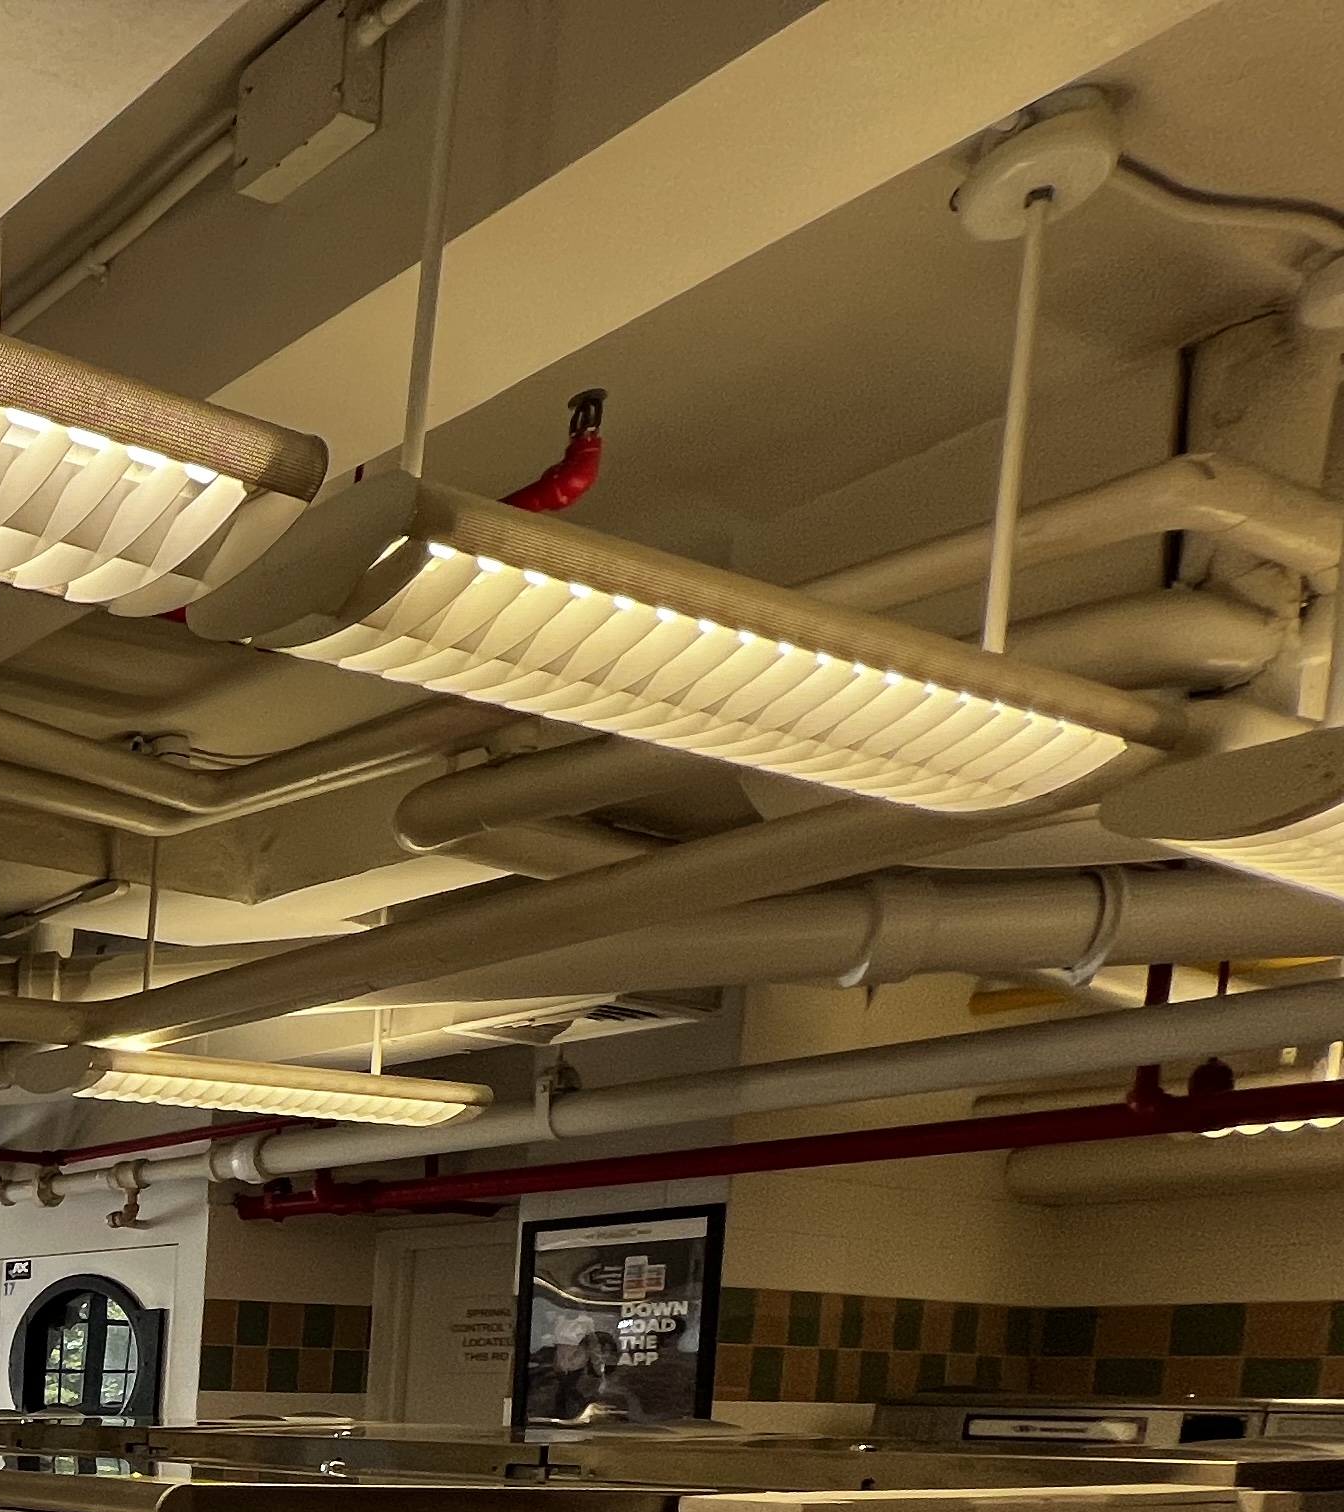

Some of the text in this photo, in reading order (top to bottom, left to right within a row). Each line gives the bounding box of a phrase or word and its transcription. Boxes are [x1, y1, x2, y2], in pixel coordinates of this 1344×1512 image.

[4, 1282, 15, 1296] 17
[621, 1301, 689, 1317] DOWN
[619, 1335, 658, 1350] THE
[491, 1352, 509, 1361] RO
[617, 1352, 659, 1366] APP
